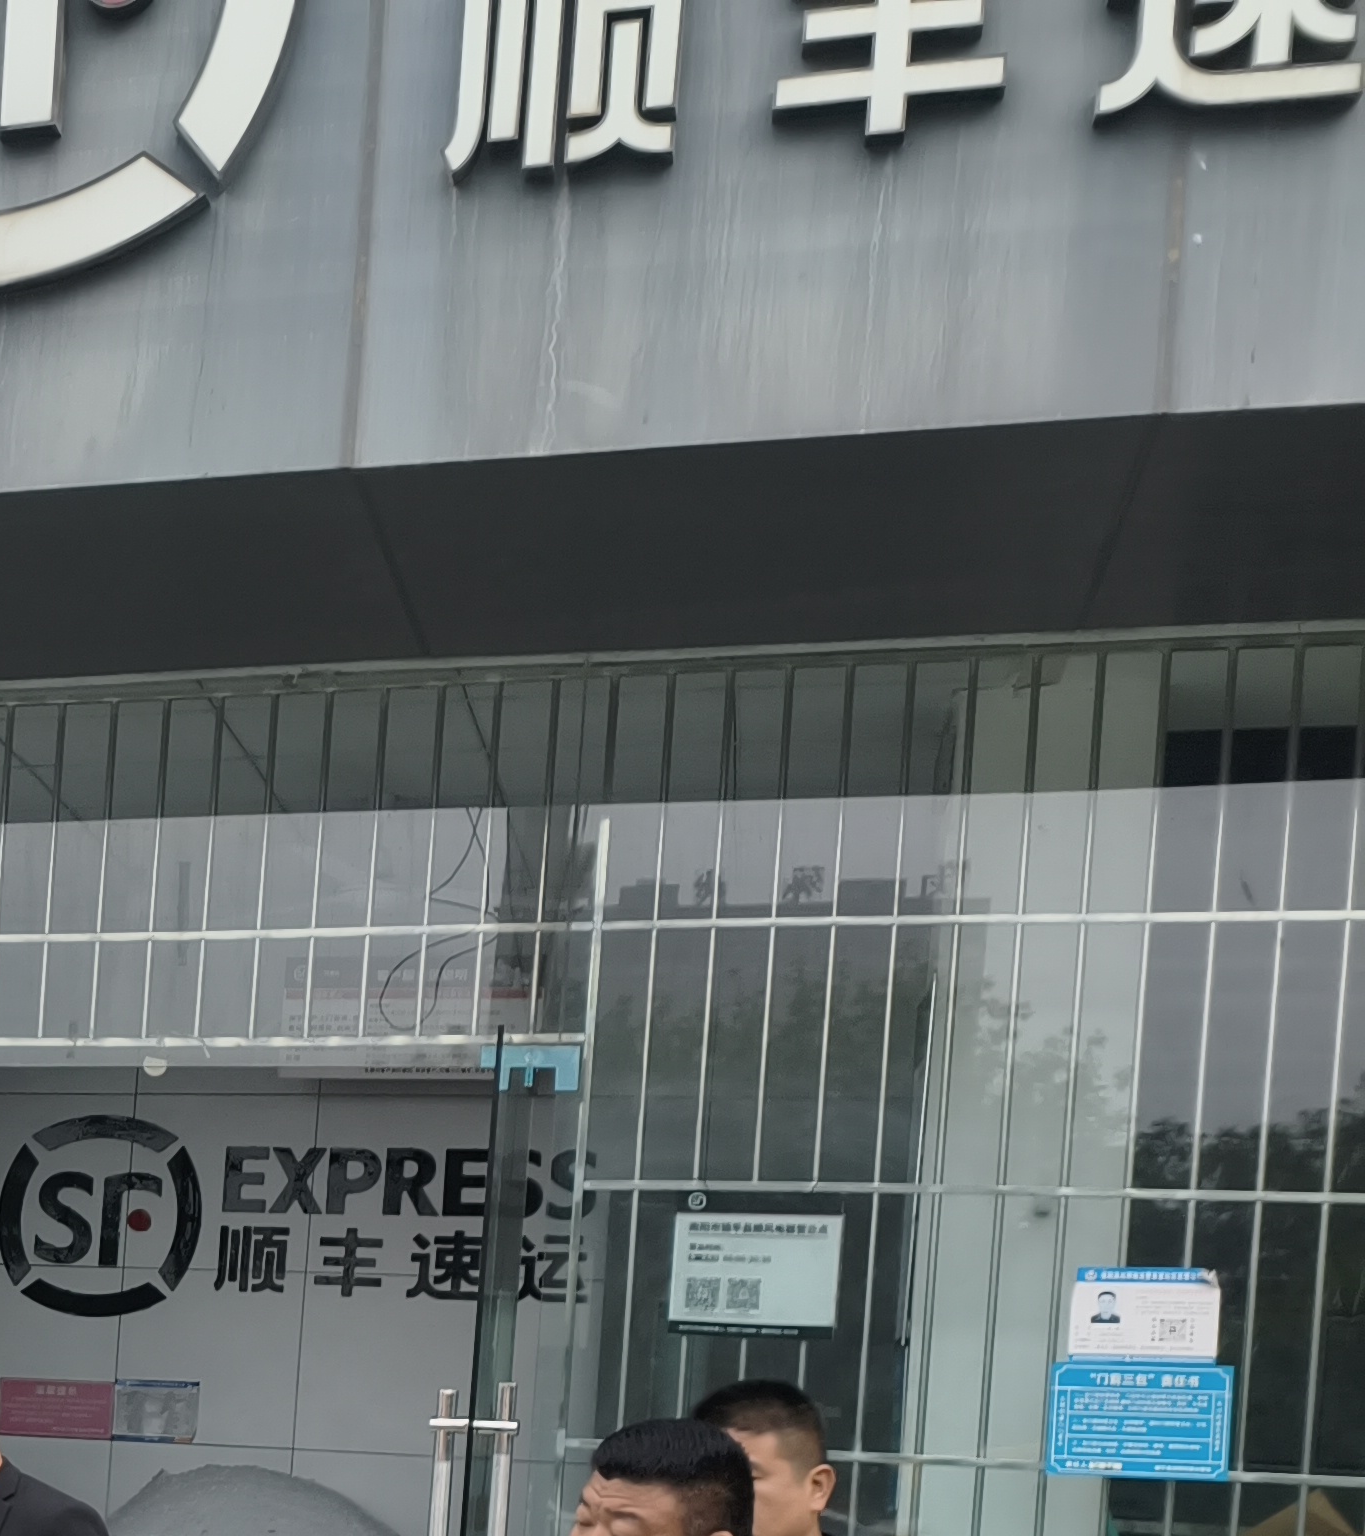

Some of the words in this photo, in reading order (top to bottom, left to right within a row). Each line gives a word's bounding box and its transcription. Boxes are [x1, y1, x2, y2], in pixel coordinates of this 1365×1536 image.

[33, 1170, 164, 1268] SF
[213, 1225, 590, 1304] 顺丰速运
